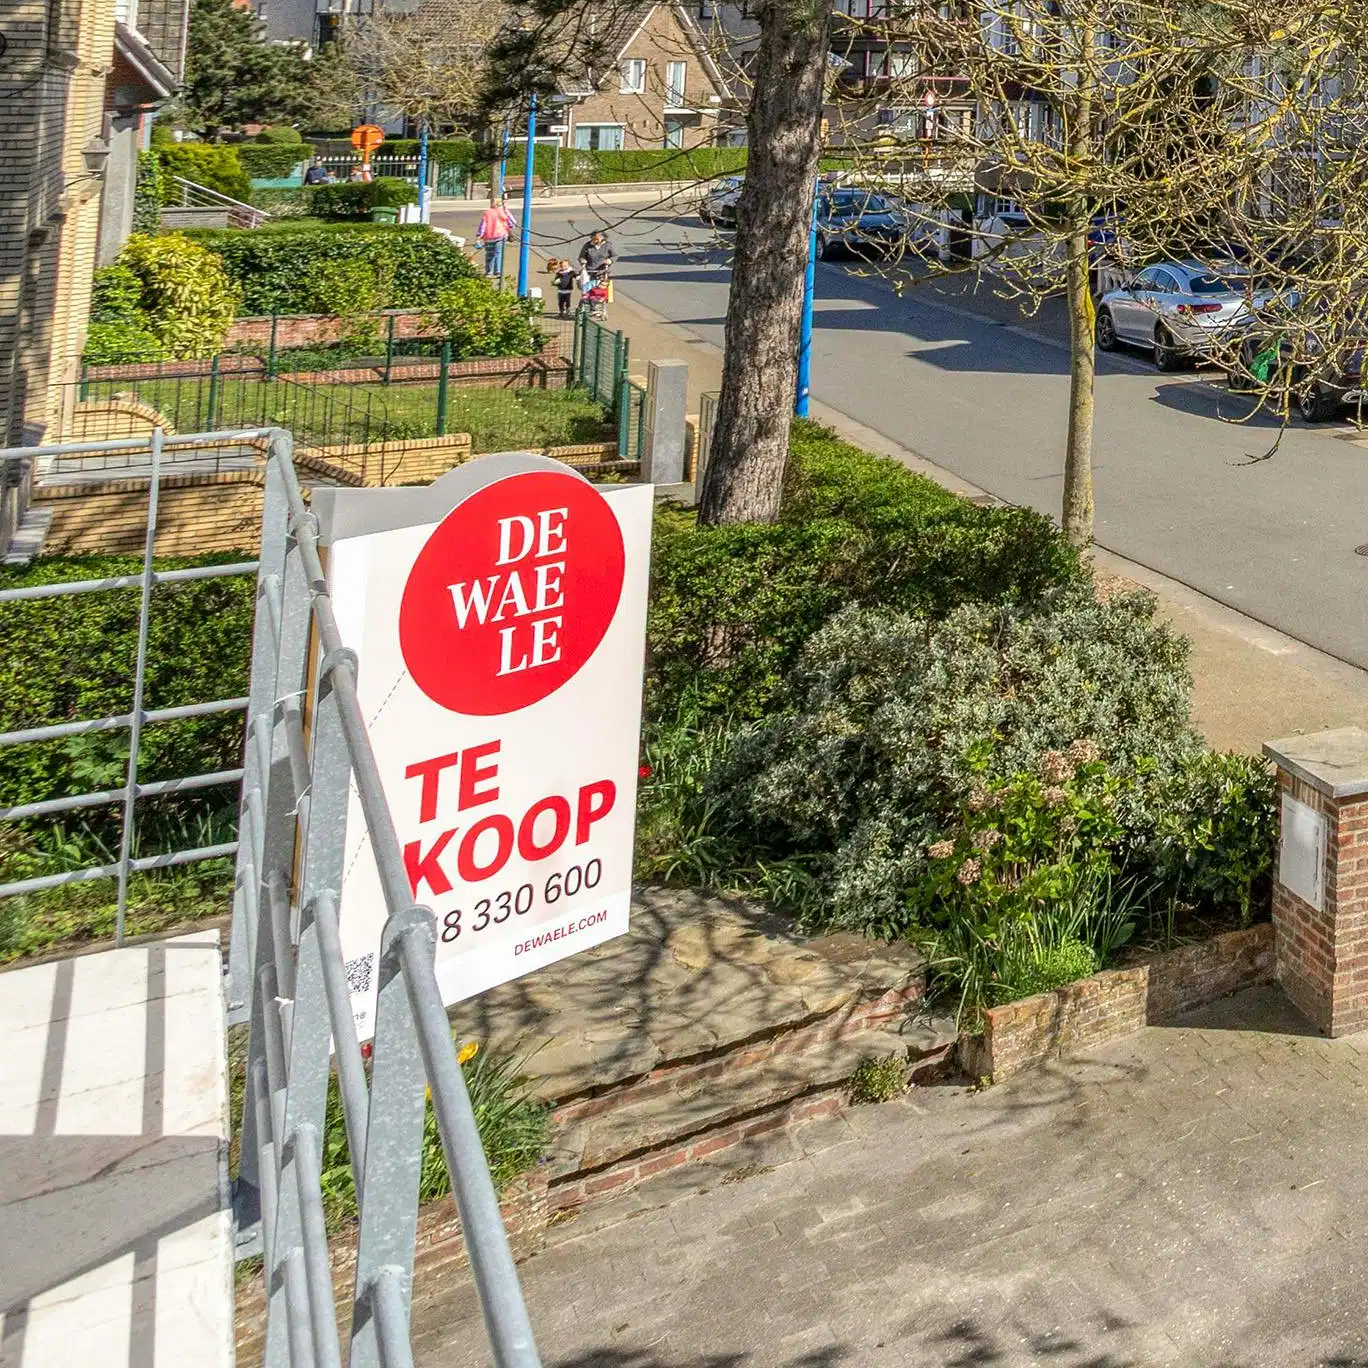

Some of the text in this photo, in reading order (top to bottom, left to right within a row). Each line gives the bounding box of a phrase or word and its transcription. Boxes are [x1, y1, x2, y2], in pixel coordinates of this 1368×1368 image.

[495, 507, 569, 567] DE
[446, 561, 566, 630] WAE
[495, 615, 563, 677] LE
[404, 739, 502, 824] TE
[403, 779, 617, 904] KOOP
[472, 883, 535, 932] 330
[544, 858, 603, 904] 600
[514, 909, 608, 957] DEWAELE.COM
